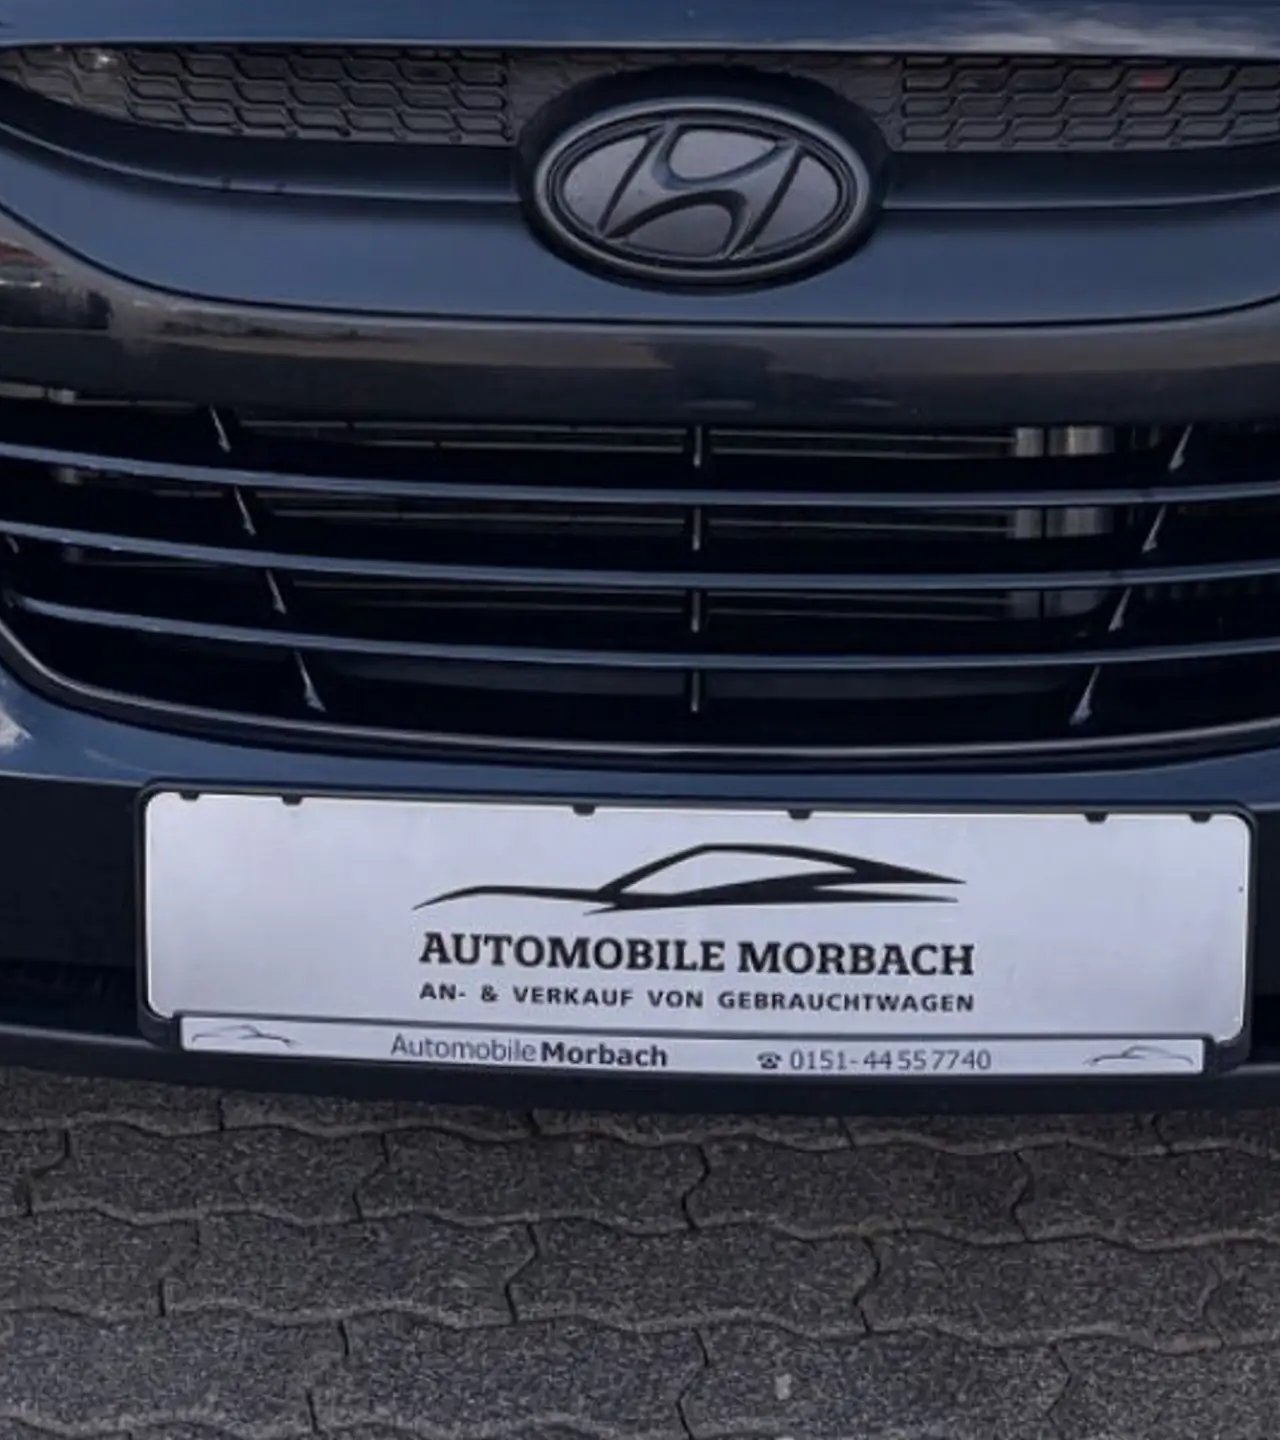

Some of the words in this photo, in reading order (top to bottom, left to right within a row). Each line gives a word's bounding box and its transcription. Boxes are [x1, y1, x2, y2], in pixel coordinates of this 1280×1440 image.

[418, 931, 726, 972] AUTOMOBILE
[736, 939, 975, 976] MORBACH
[419, 981, 467, 1001] AN-
[479, 984, 498, 1003] &
[512, 986, 634, 1008] VERKAUF
[647, 989, 704, 1009] VON
[717, 990, 975, 1013] GEBRAUCHTWAGEN
